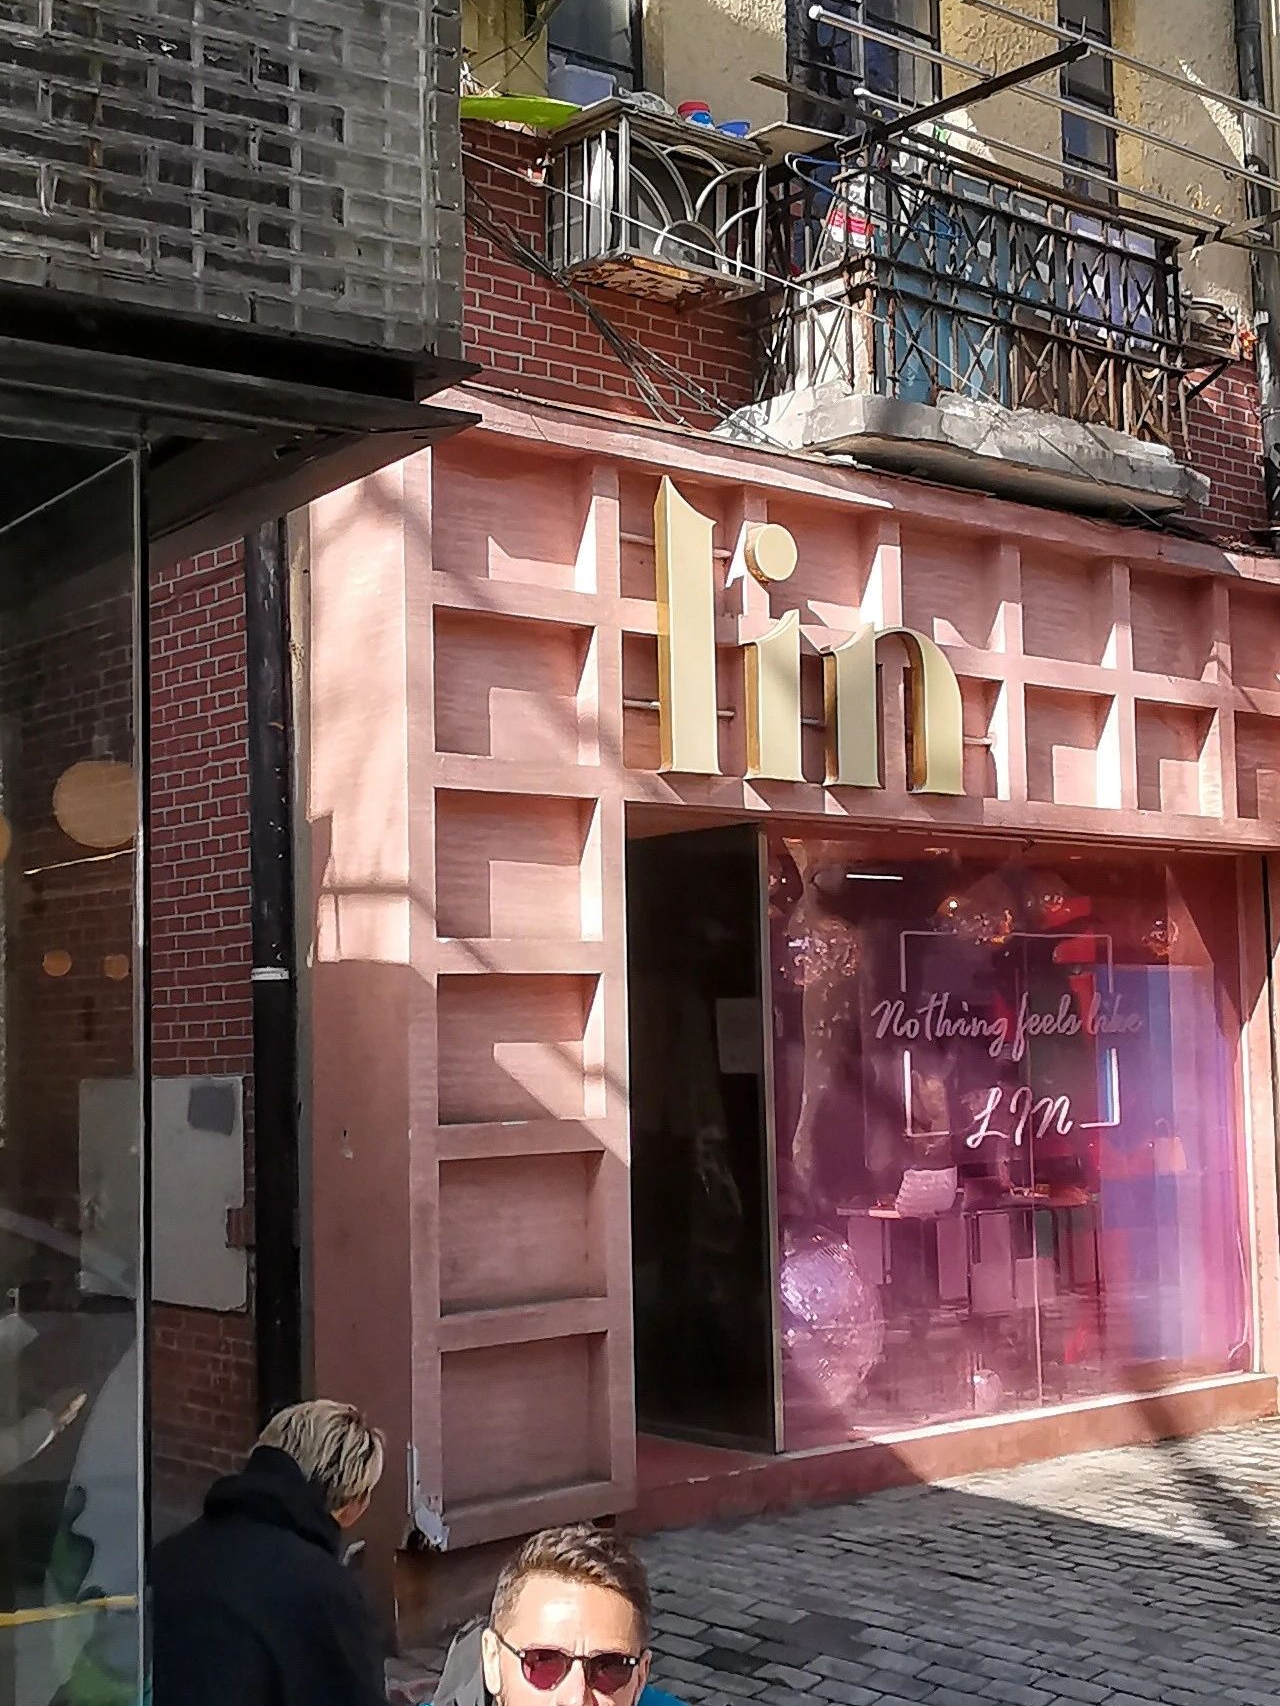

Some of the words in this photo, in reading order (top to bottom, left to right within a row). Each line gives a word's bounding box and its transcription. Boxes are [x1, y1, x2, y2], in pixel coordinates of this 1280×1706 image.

[655, 474, 965, 796] lin
[870, 991, 1010, 1058] Nothing
[1011, 990, 1082, 1062] feels
[1086, 990, 1144, 1036] like
